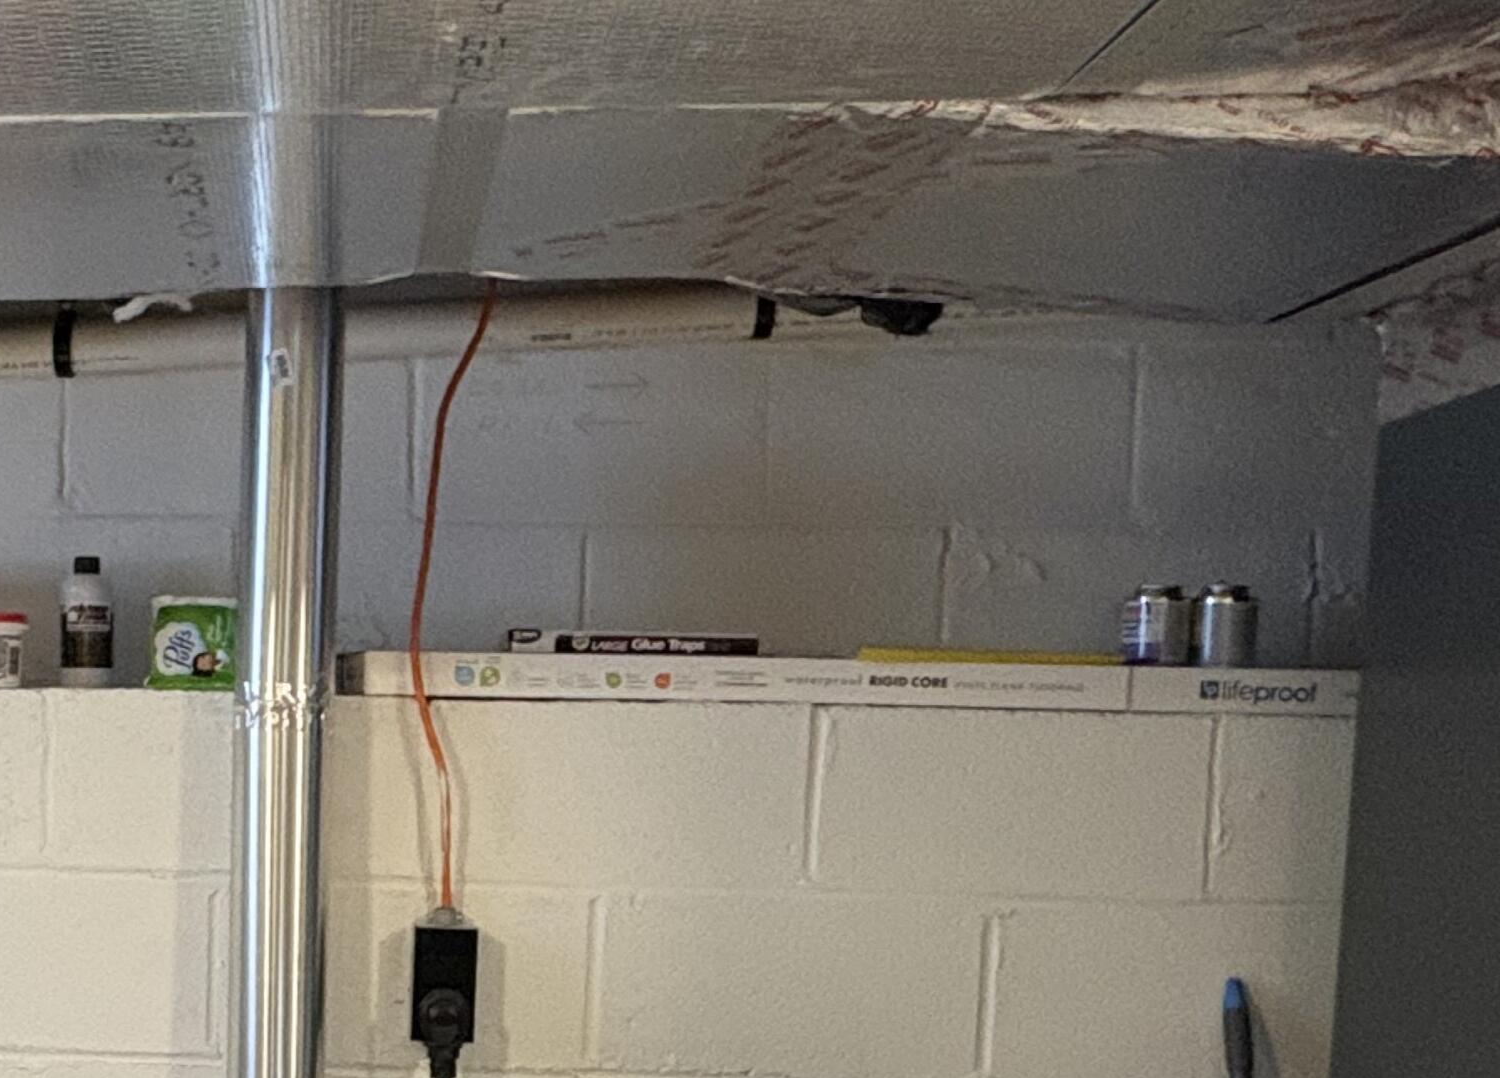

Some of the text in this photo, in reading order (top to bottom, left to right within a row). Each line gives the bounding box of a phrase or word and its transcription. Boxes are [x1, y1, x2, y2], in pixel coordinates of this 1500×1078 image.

[162, 629, 196, 669] Puffs
[631, 637, 666, 651] Glue
[668, 638, 707, 653] Traps
[869, 675, 909, 687] RIGID
[911, 676, 949, 689] CORE
[1222, 680, 1318, 705] lifeproof
